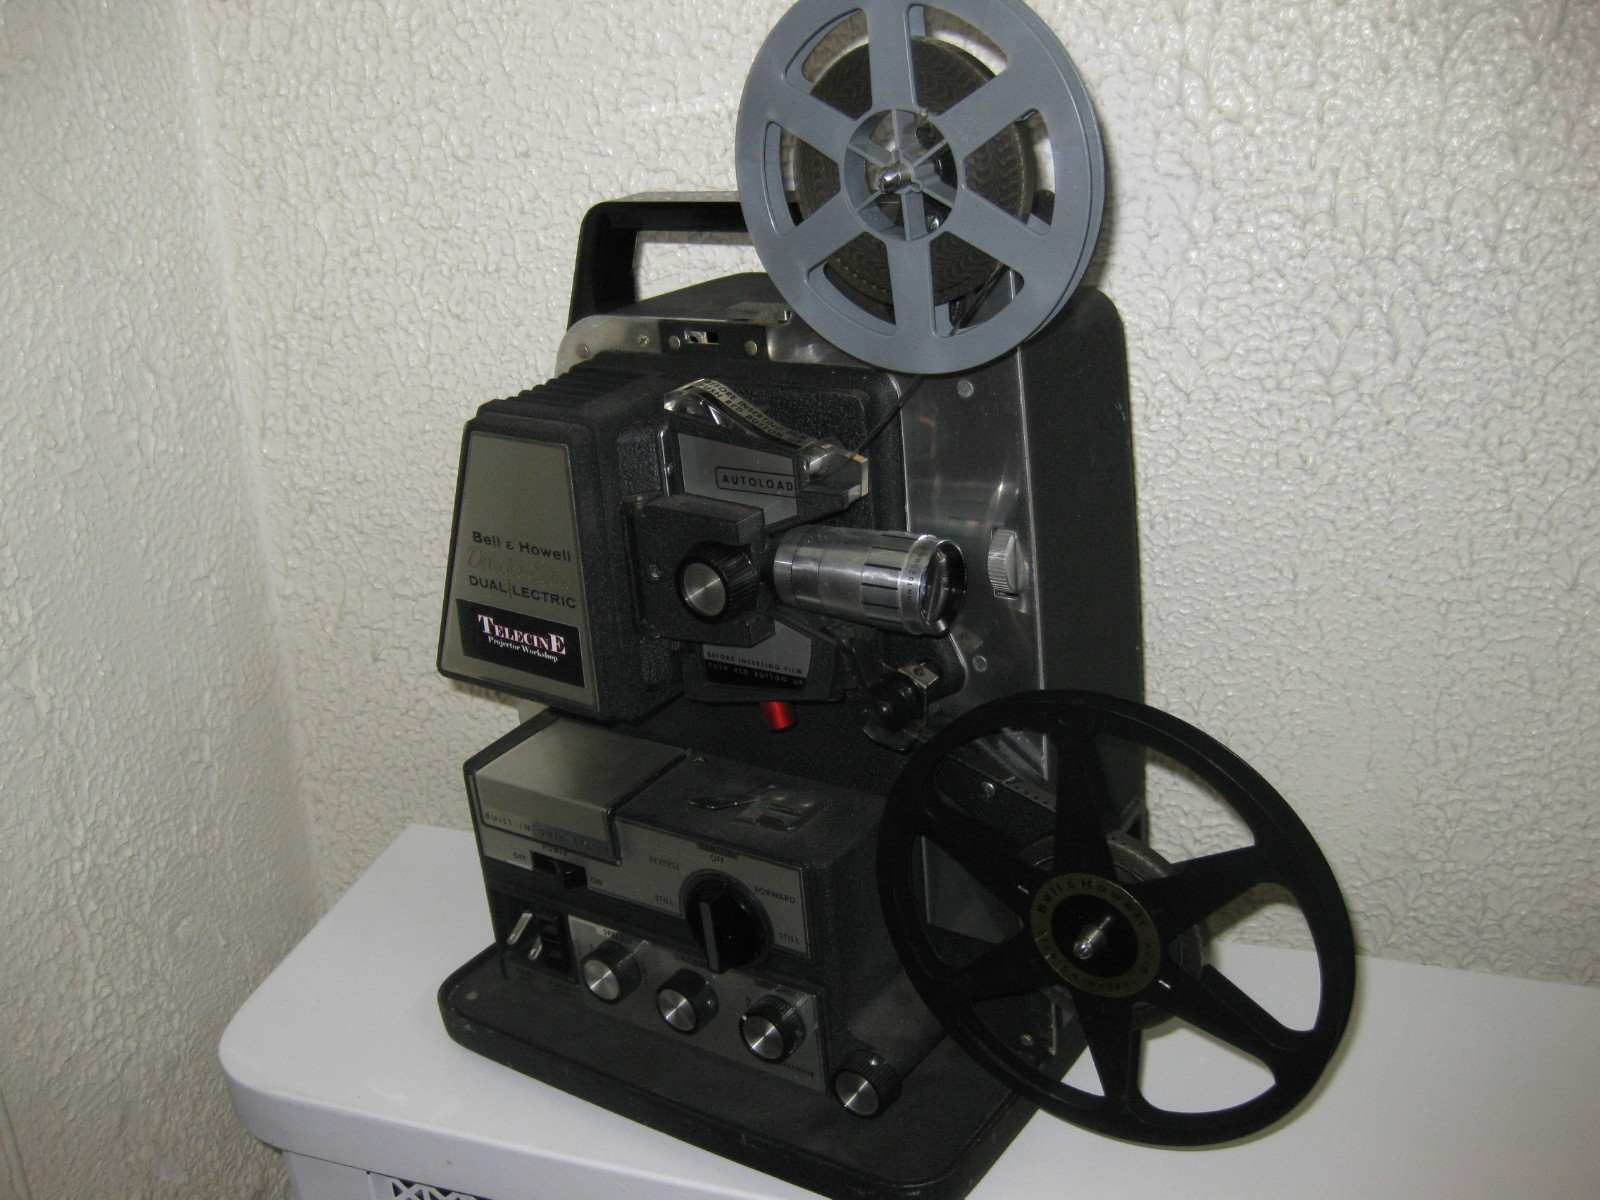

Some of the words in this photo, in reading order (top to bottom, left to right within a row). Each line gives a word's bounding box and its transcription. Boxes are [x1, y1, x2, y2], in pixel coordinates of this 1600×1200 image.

[724, 399, 743, 413] RED
[722, 474, 794, 491] AUTOLOAD
[471, 530, 501, 548] Bell
[519, 541, 571, 562] Howell
[468, 575, 508, 593] DUAL
[478, 614, 566, 655] TELECINE
[488, 635, 521, 652] Projector
[521, 644, 558, 662] Workshop
[706, 651, 734, 662] BEFORE
[739, 657, 780, 671] INSERTING
[783, 666, 803, 675] FILM
[707, 661, 729, 671] PUSH
[754, 670, 787, 683] BUTTON
[648, 855, 681, 871] REVERSE
[709, 854, 725, 864] OFF
[590, 877, 603, 886] ON
[655, 894, 673, 905] STILL
[754, 886, 796, 904] FORWARD
[778, 932, 800, 944] STILL
